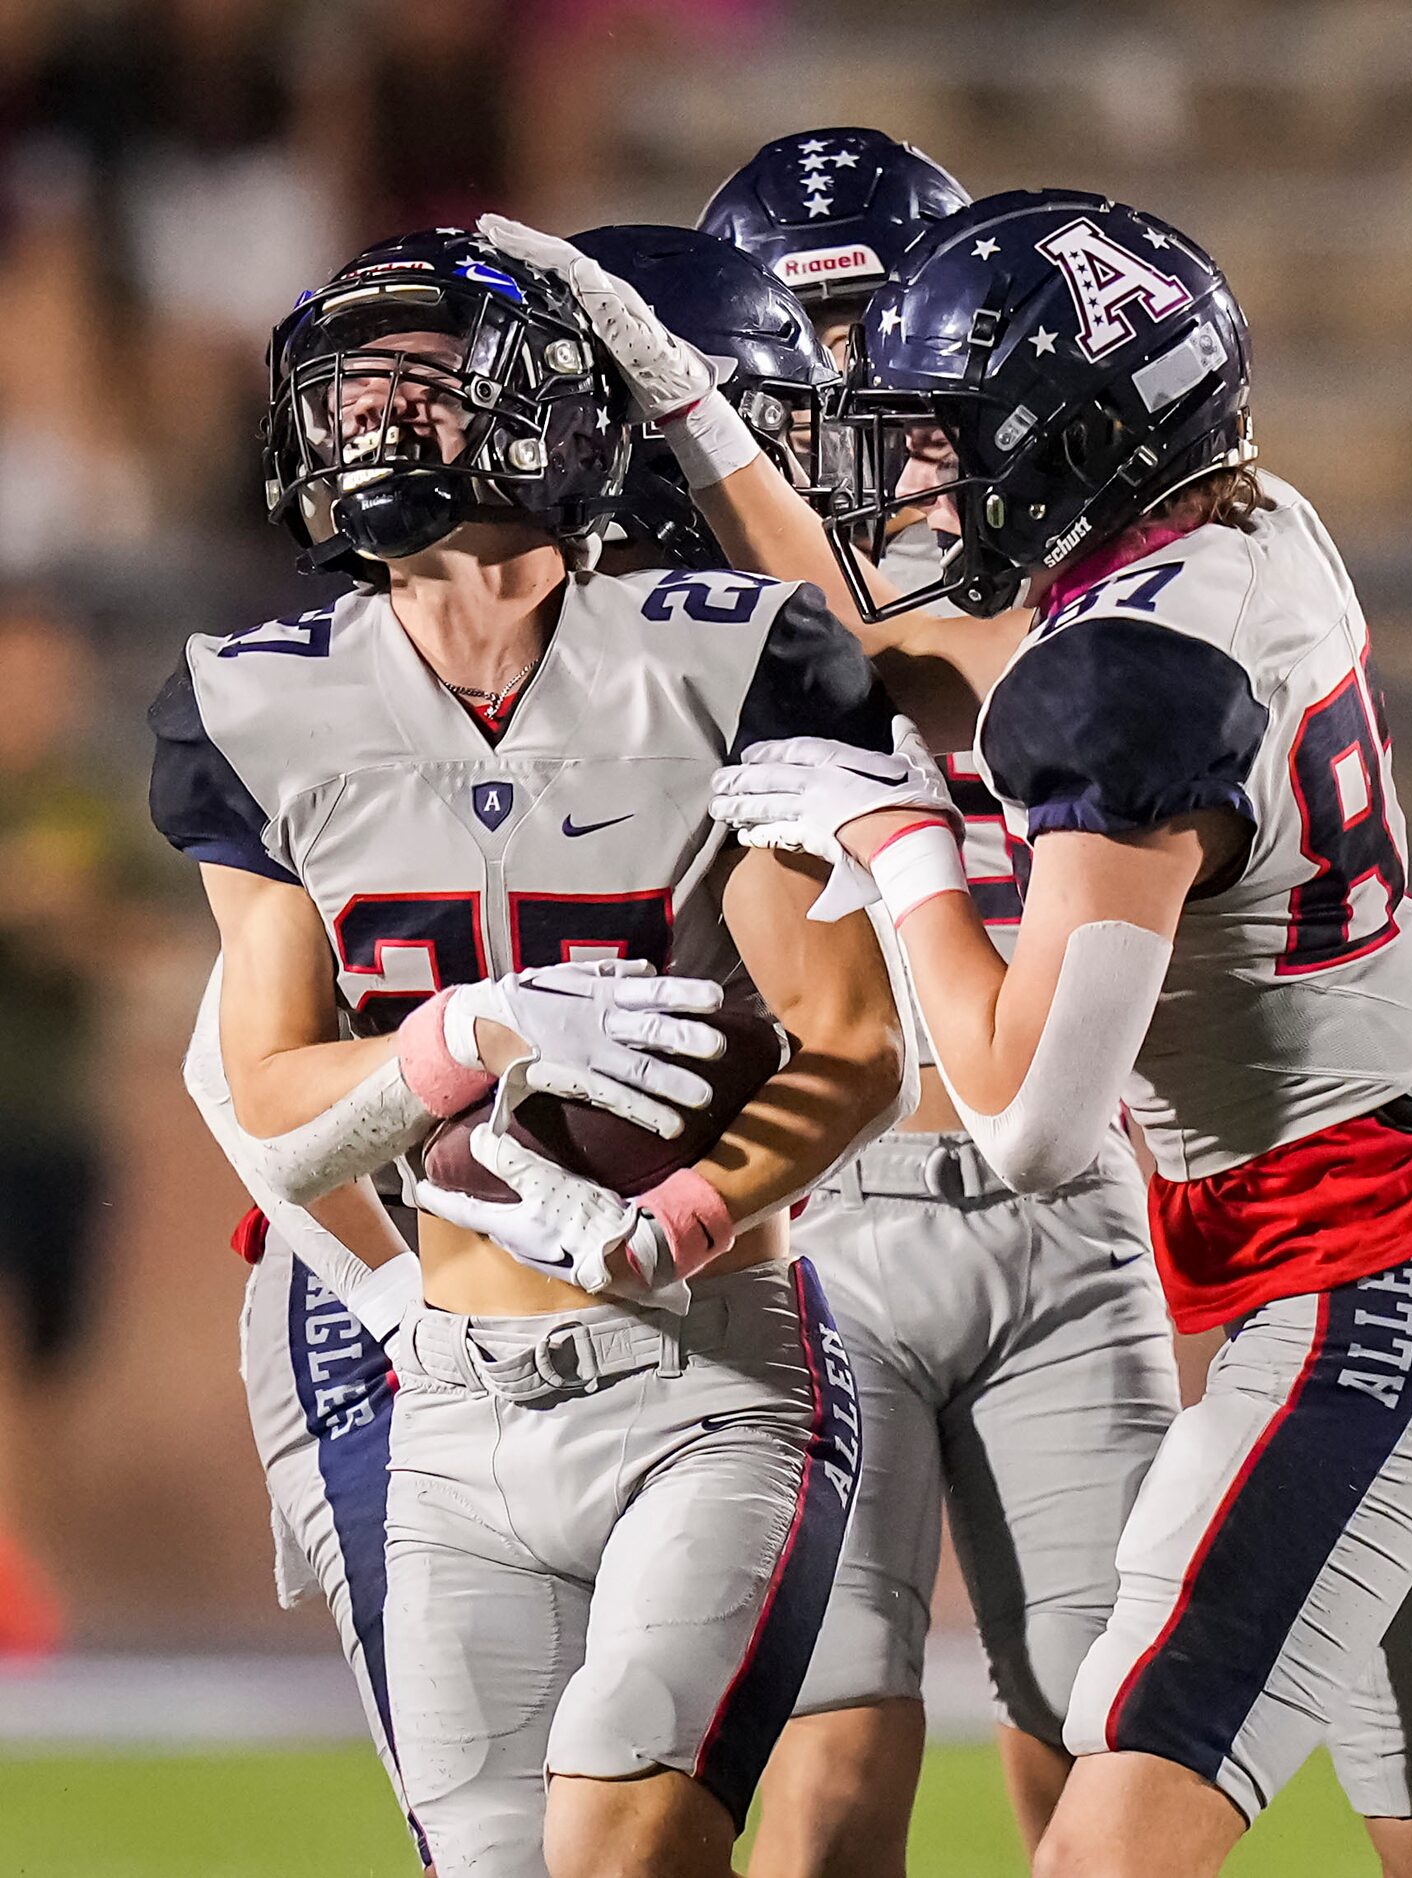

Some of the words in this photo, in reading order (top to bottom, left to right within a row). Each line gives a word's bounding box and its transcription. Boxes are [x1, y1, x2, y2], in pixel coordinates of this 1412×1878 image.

[1034, 216, 1193, 364] A
[1043, 515, 1093, 568] schutt
[483, 790, 501, 812] A
[818, 1321, 860, 1511] ALLEN
